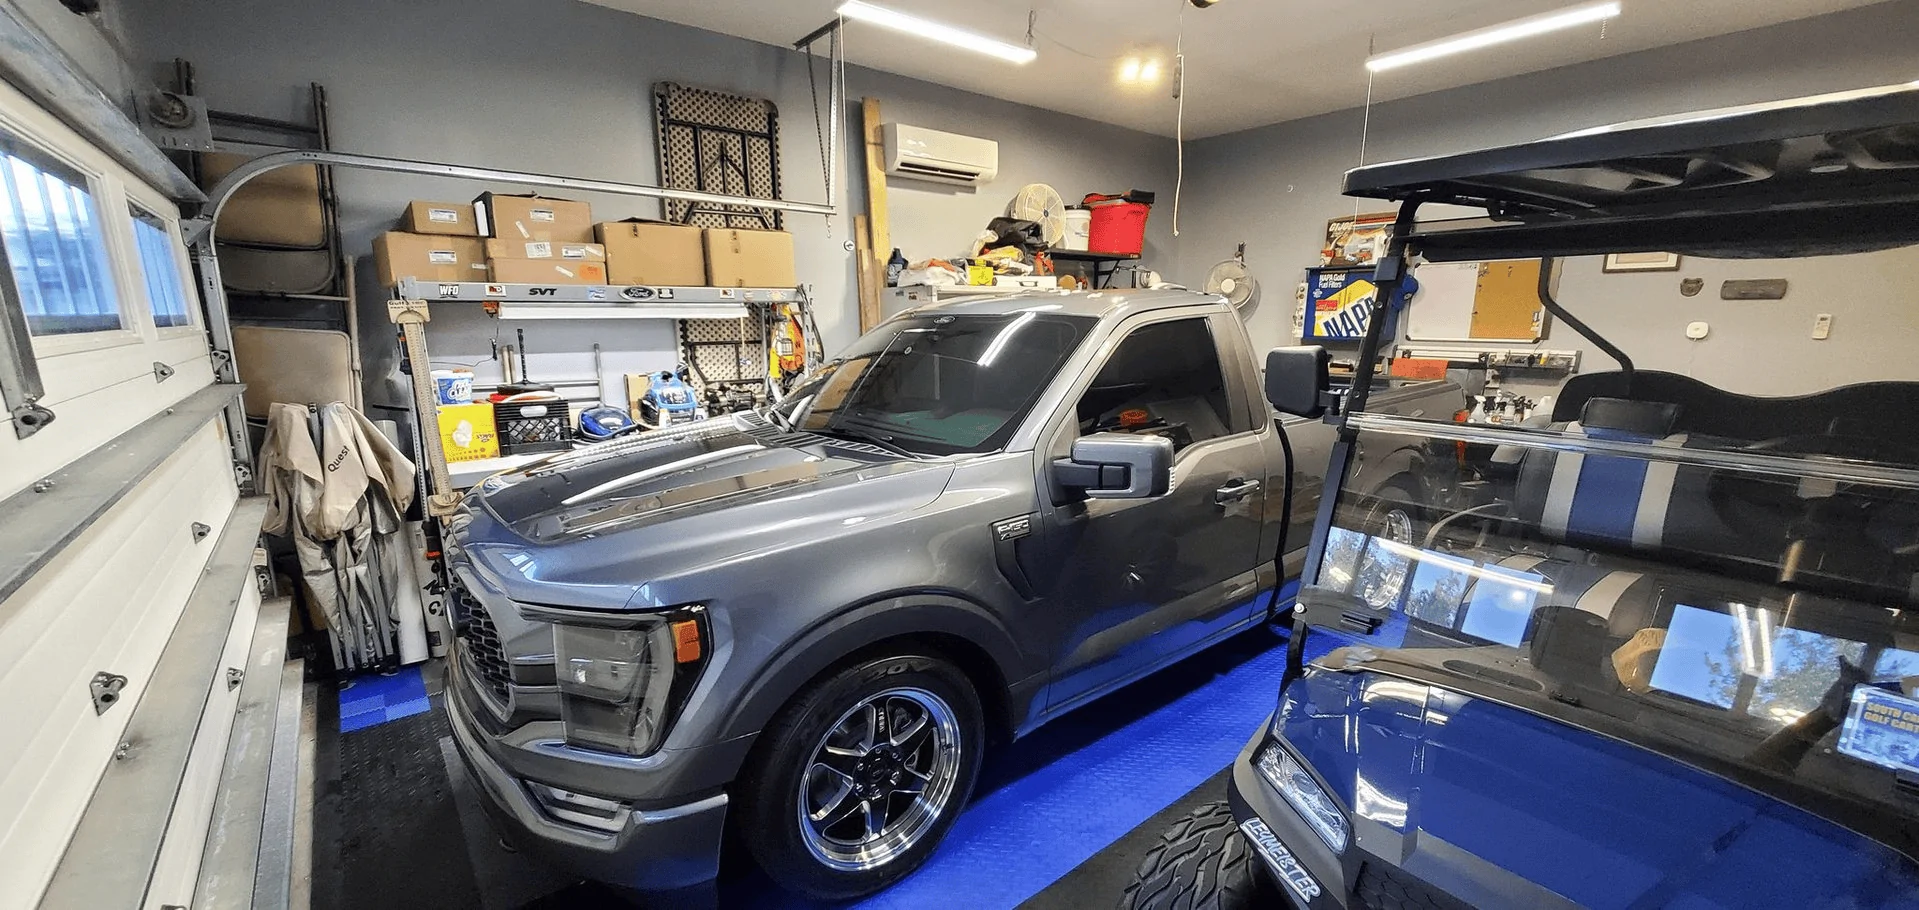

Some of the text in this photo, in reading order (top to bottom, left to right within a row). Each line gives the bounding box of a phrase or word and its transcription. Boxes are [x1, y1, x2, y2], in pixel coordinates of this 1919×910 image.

[1320, 273, 1346, 282] NAPA Gold
[439, 284, 460, 295] WFO
[1330, 280, 1342, 288] Filters
[529, 287, 558, 296] SVT
[626, 287, 653, 298] Ford
[1323, 296, 1376, 337] NAPA
[327, 445, 351, 472] Quest
[1244, 817, 1321, 902] LEYMEISTER
